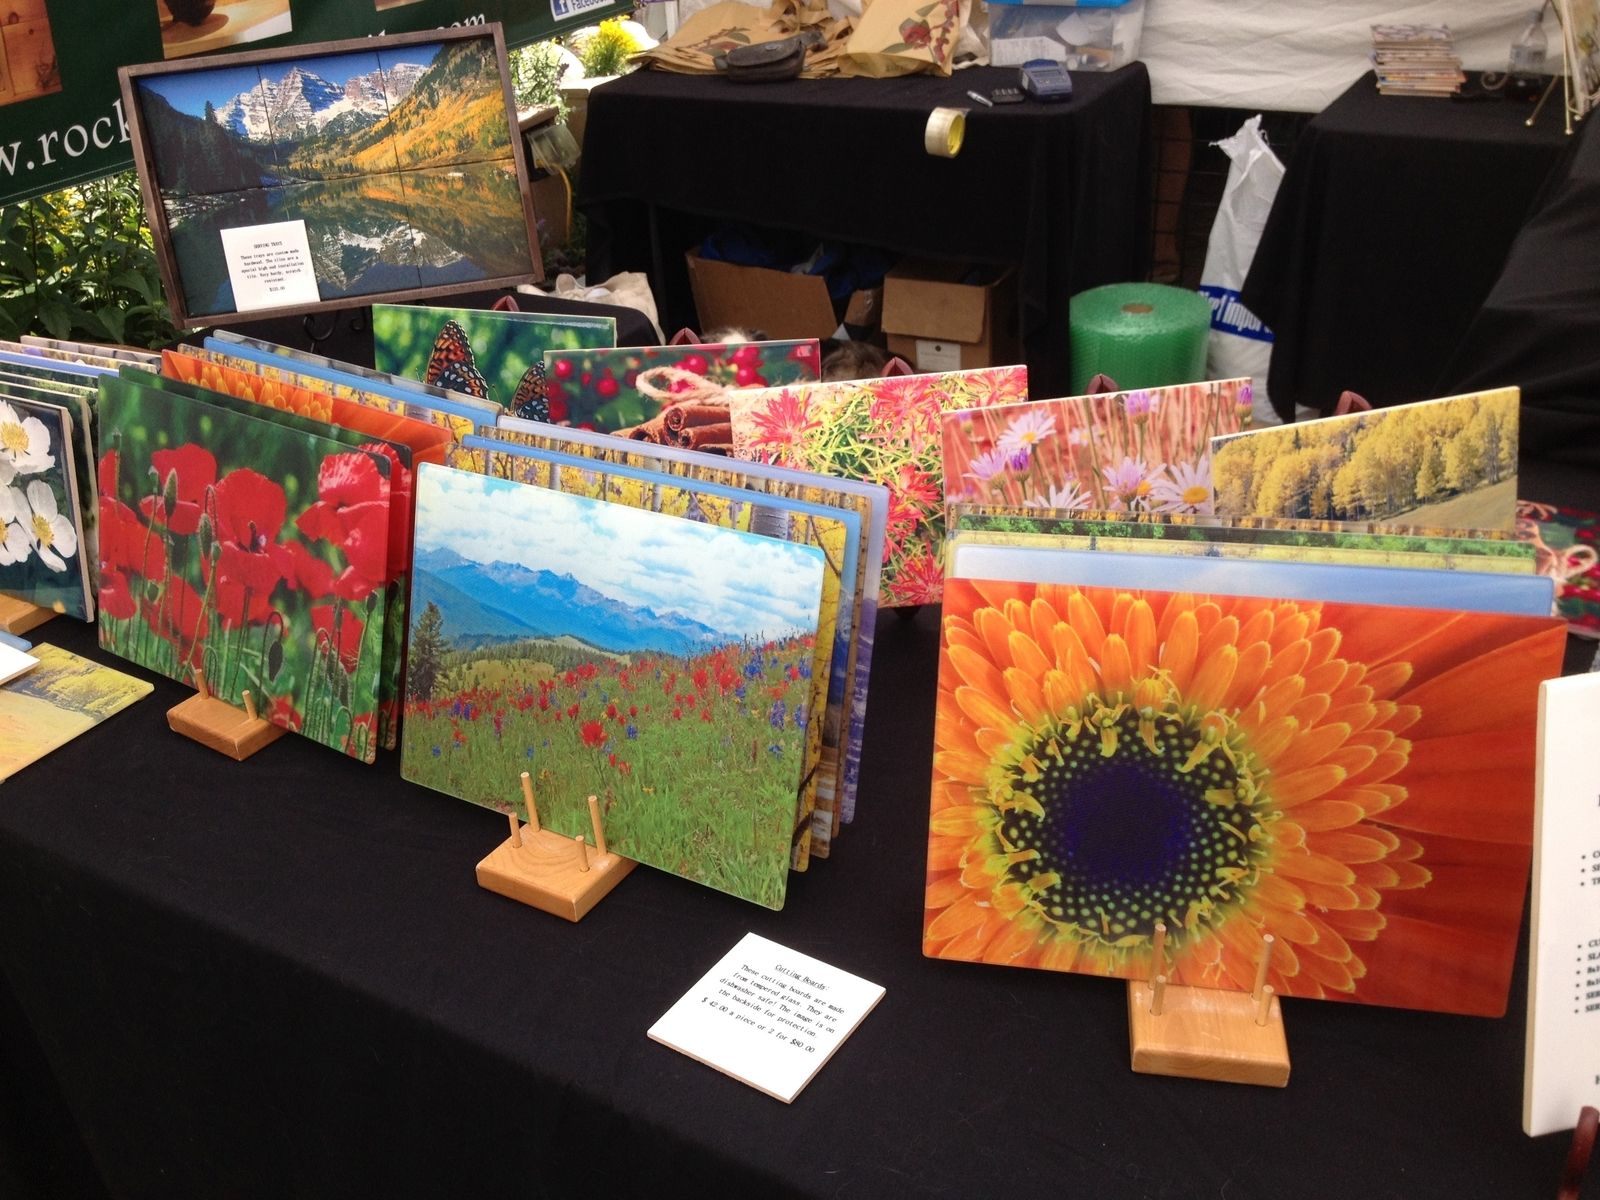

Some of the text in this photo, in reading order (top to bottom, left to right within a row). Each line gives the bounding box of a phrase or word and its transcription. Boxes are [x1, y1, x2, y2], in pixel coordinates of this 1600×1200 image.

[741, 964, 845, 1014] These cutting boards are made
[775, 964, 802, 981] Cutting
[718, 989, 817, 1038] the backside for protection.
[719, 978, 755, 997] dishwasher
[757, 995, 778, 1007] safe!
[779, 1003, 791, 1014] The
[793, 1011, 813, 1024] image
[815, 1020, 824, 1028] is
[733, 972, 837, 1023] from tempered glass. They are
[735, 1014, 756, 1026] piece
[775, 1032, 788, 1041] for
[789, 1038, 816, 1053] $80.00
